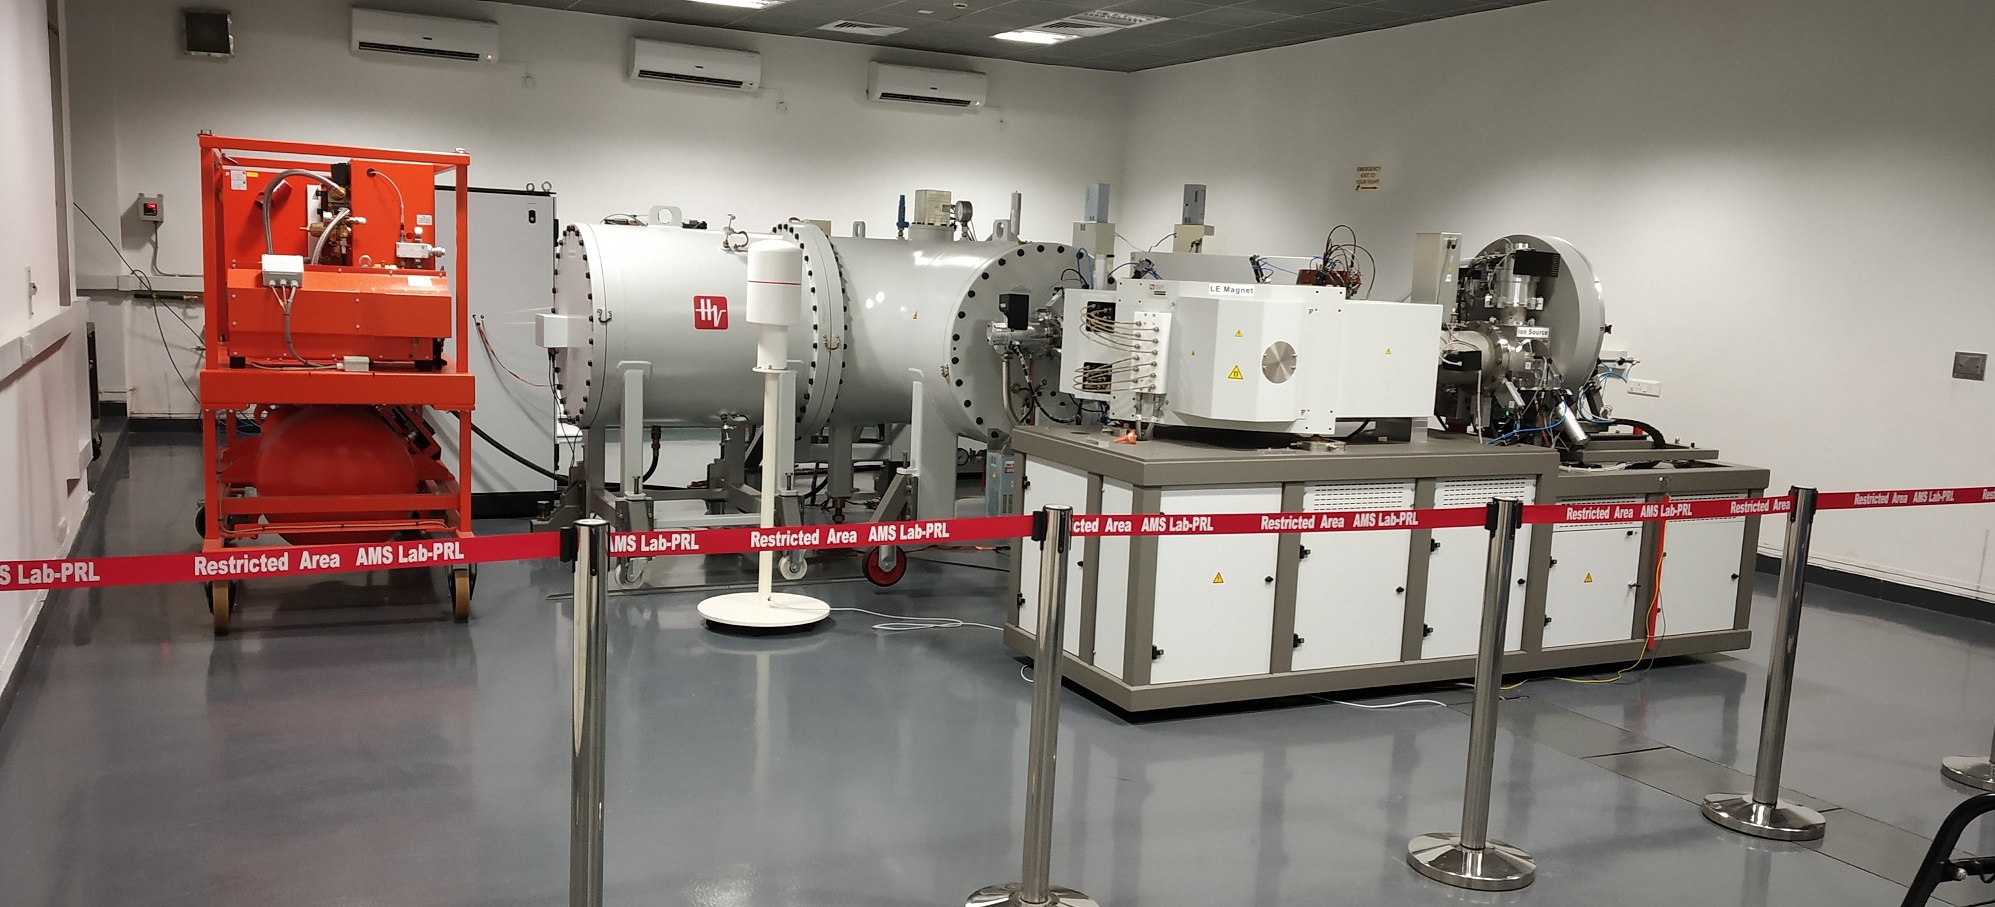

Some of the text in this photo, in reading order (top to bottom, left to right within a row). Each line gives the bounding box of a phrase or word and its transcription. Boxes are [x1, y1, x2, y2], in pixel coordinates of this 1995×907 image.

[1210, 285, 1254, 295] LE Magnet
[1529, 328, 1548, 336] Source
[1854, 490, 1954, 505] Restricted Area AMS Lab-PRL
[1567, 504, 1692, 520] Restricted Area AMS Lab-PRL
[1731, 499, 1790, 514] Restricted Area
[1105, 518, 1131, 532] Area
[1141, 517, 1166, 531] AMS
[1169, 517, 1213, 531] Lab-PRL
[1261, 512, 1418, 529] Restricted Area AMS Lab-PRL
[641, 534, 699, 551] Lab-PRL
[751, 523, 949, 548] Restricted Area AMS Lab-PRL
[195, 541, 465, 575] Restricted Area AMS Lab-PRL
[18, 562, 100, 584] Lab-PRL
